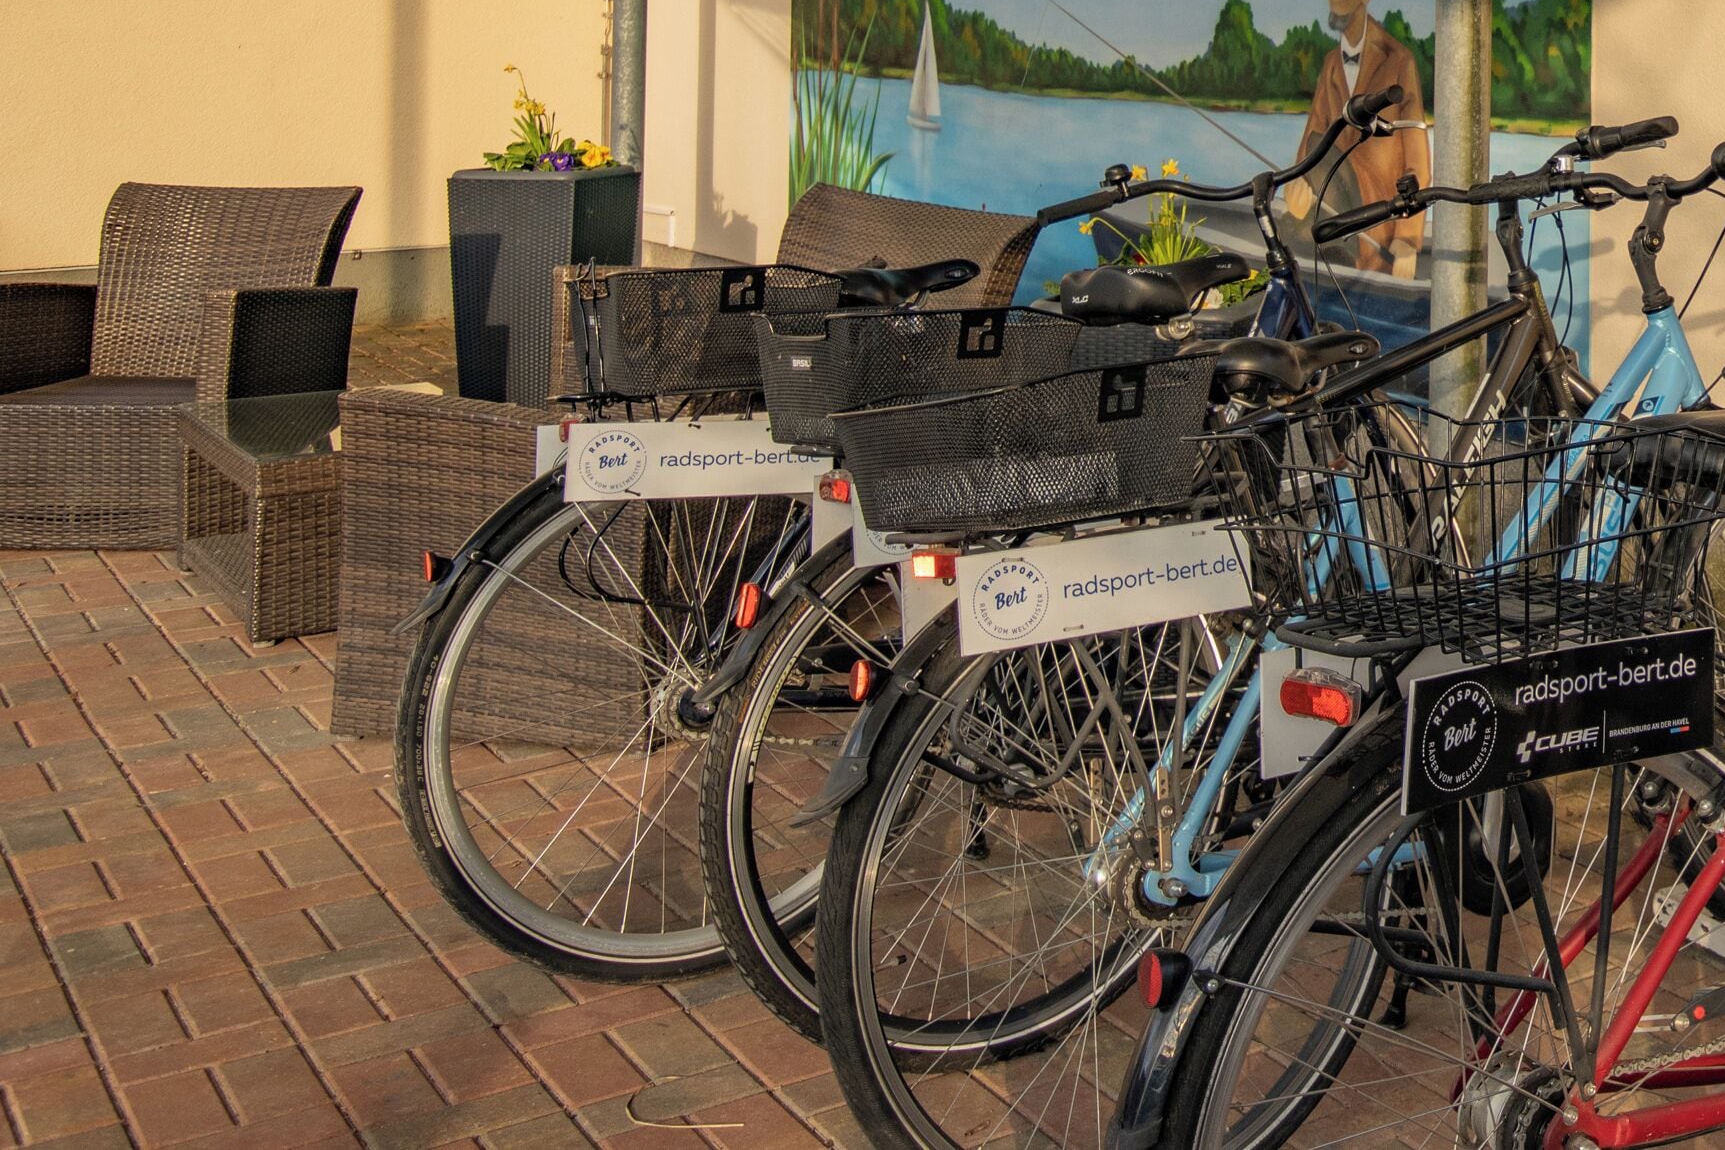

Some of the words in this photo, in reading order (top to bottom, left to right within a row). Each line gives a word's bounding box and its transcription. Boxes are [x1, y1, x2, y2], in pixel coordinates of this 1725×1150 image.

[588, 434, 641, 454] RADSPORT
[599, 452, 628, 469] Bert
[981, 565, 1039, 592] RADSPORT
[1063, 554, 1238, 598] radsport-bert.de
[995, 586, 1028, 610] Bert
[994, 625, 1009, 635] VOM
[1011, 593, 1044, 634] WELTMEISTER
[1515, 652, 1697, 706] radsport-bert.de
[1433, 688, 1491, 726] RADSPORT
[1444, 717, 1477, 751] Bert
[1534, 726, 1600, 751] CUBE
[1609, 722, 1651, 738] BRANDENBURG
[1651, 722, 1660, 730] AN
[1660, 719, 1672, 728] DER
[1672, 717, 1690, 727] HAVEL
[1438, 770, 1453, 784] VOM
[1455, 726, 1491, 784] WELTMEISTER
